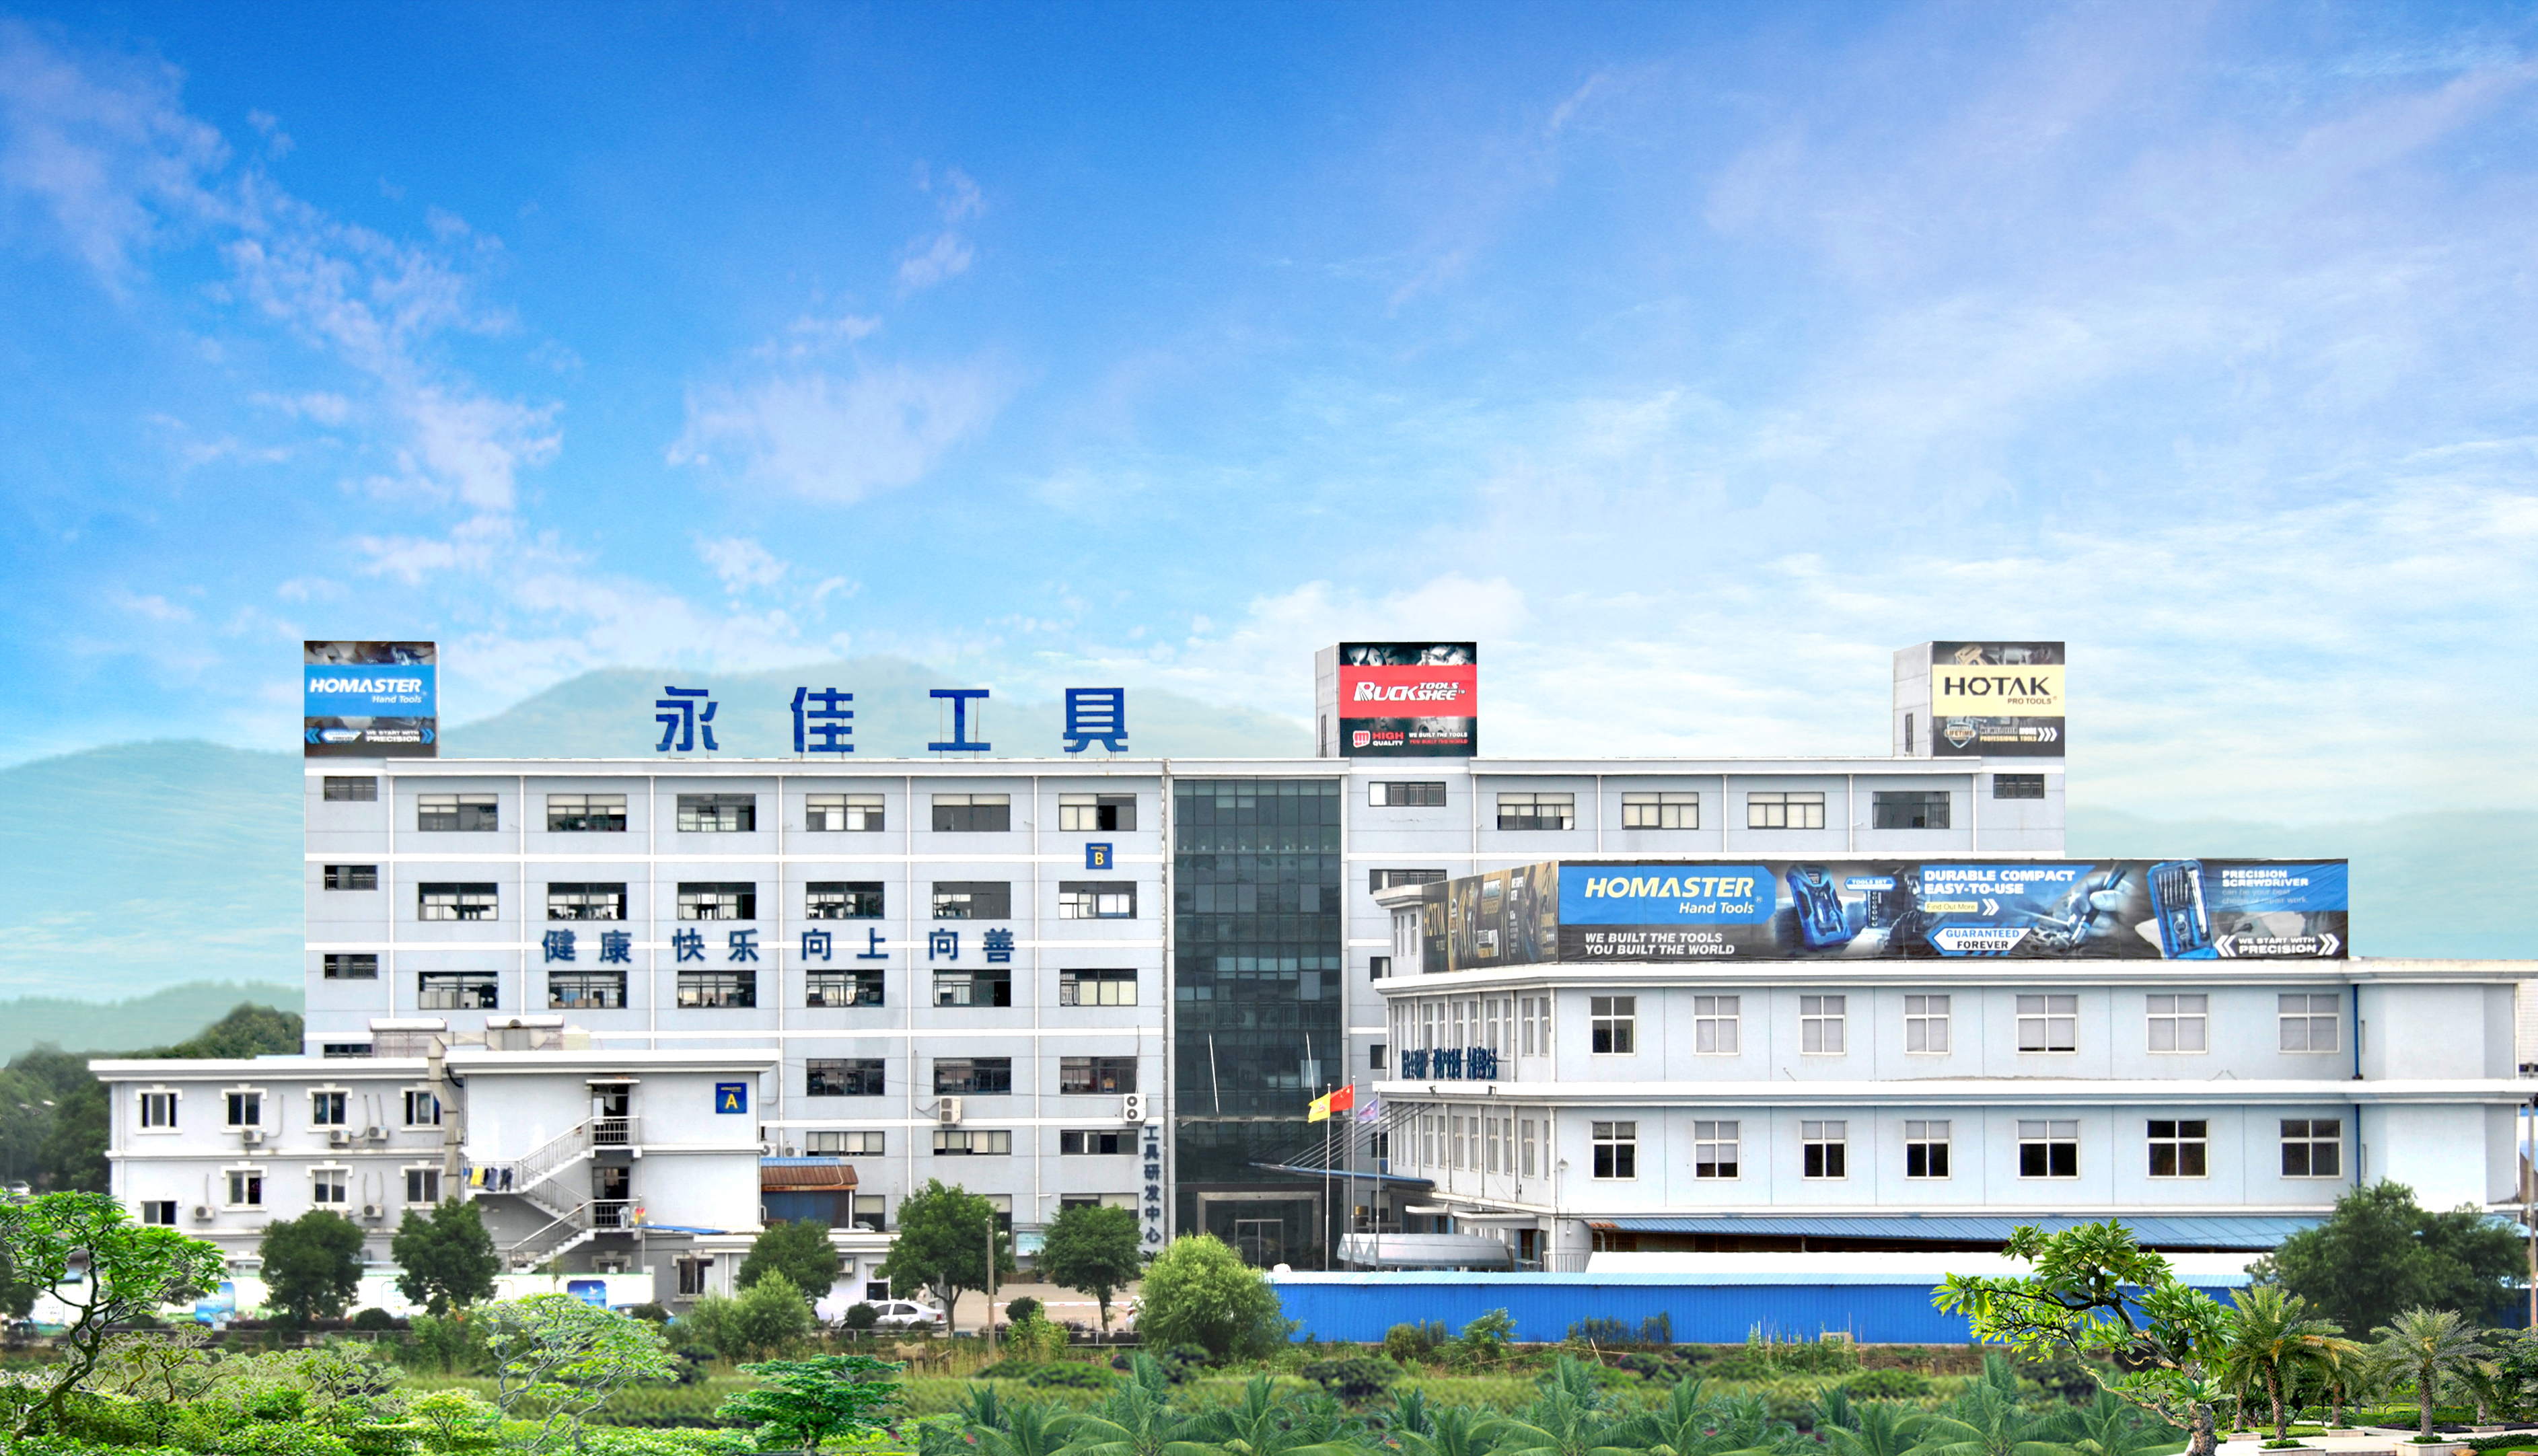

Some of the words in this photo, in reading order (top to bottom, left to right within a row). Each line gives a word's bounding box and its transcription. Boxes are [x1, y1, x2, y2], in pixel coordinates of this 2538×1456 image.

[310, 679, 423, 693] HOMASTER
[1945, 677, 2051, 696] HOTAK
[1095, 852, 1104, 865] B
[1924, 871, 1996, 881] DURABLE
[2000, 870, 2076, 881] COMPACT
[2222, 870, 2287, 879] PRECISION
[1585, 877, 1754, 898] HOMASTER
[2222, 878, 2309, 887] SCREWDRIVER
[1924, 883, 2024, 894] EASY-TO-USE
[1679, 902, 1715, 914] Hand
[1720, 902, 1754, 914] Tools
[1423, 902, 1446, 937] HOTAK
[1585, 933, 1605, 943] WE
[1608, 933, 1646, 943] BUILT
[1650, 933, 1676, 943] THE
[1679, 933, 1723, 943] TOOLS
[1946, 930, 2020, 938] GUARANTEED
[1585, 945, 1613, 955] YOU
[1617, 945, 1655, 955] BUILT
[1659, 945, 1685, 955] THE
[1688, 945, 1735, 955] WORLD
[1957, 941, 2008, 949] FOREVER
[2239, 944, 2317, 954] PRECISION
[725, 1093, 738, 1109] A
[1143, 1126, 1161, 1243] 工具研发中心
